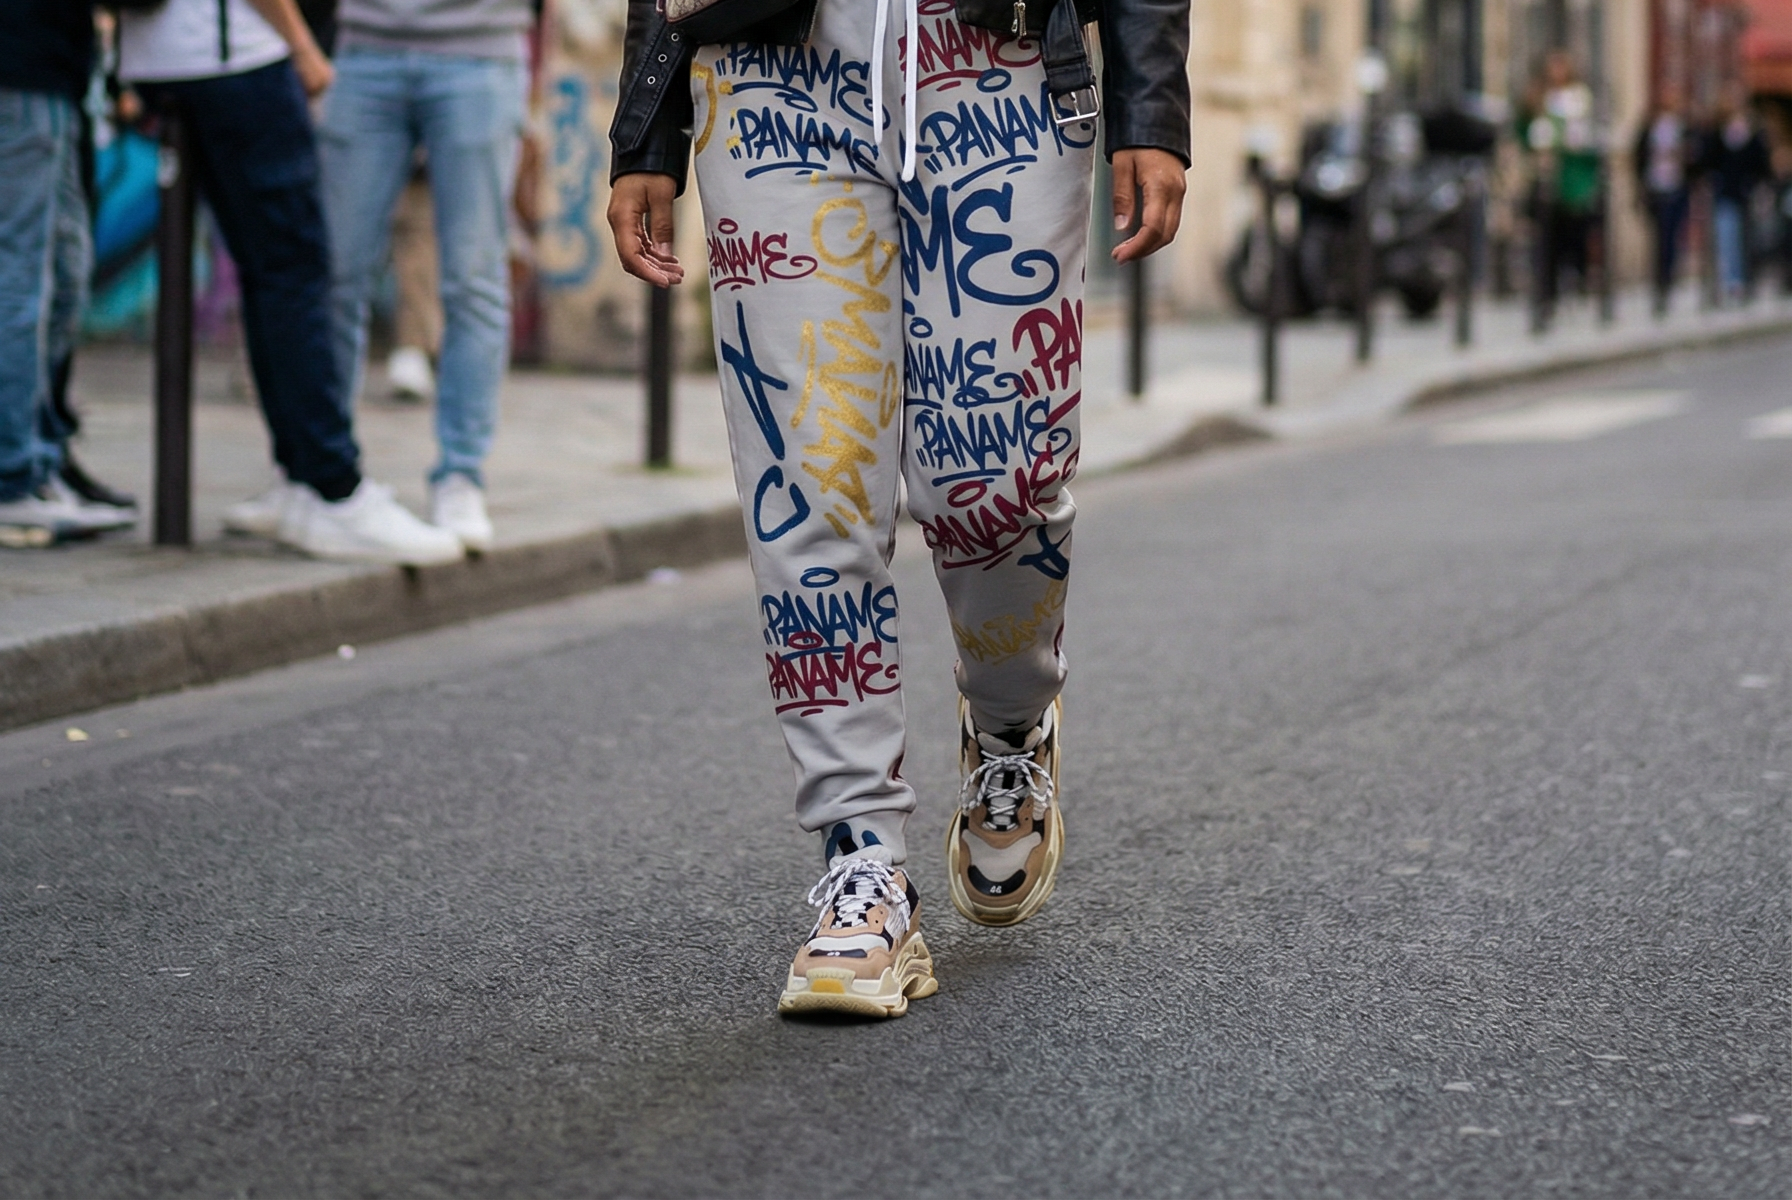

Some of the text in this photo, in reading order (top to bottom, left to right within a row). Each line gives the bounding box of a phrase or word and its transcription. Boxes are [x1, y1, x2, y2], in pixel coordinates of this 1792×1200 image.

[904, 337, 1027, 408] NAME
[1013, 297, 1083, 391] PA
[915, 396, 1072, 469] PANAME
[761, 581, 899, 648] PANAME
